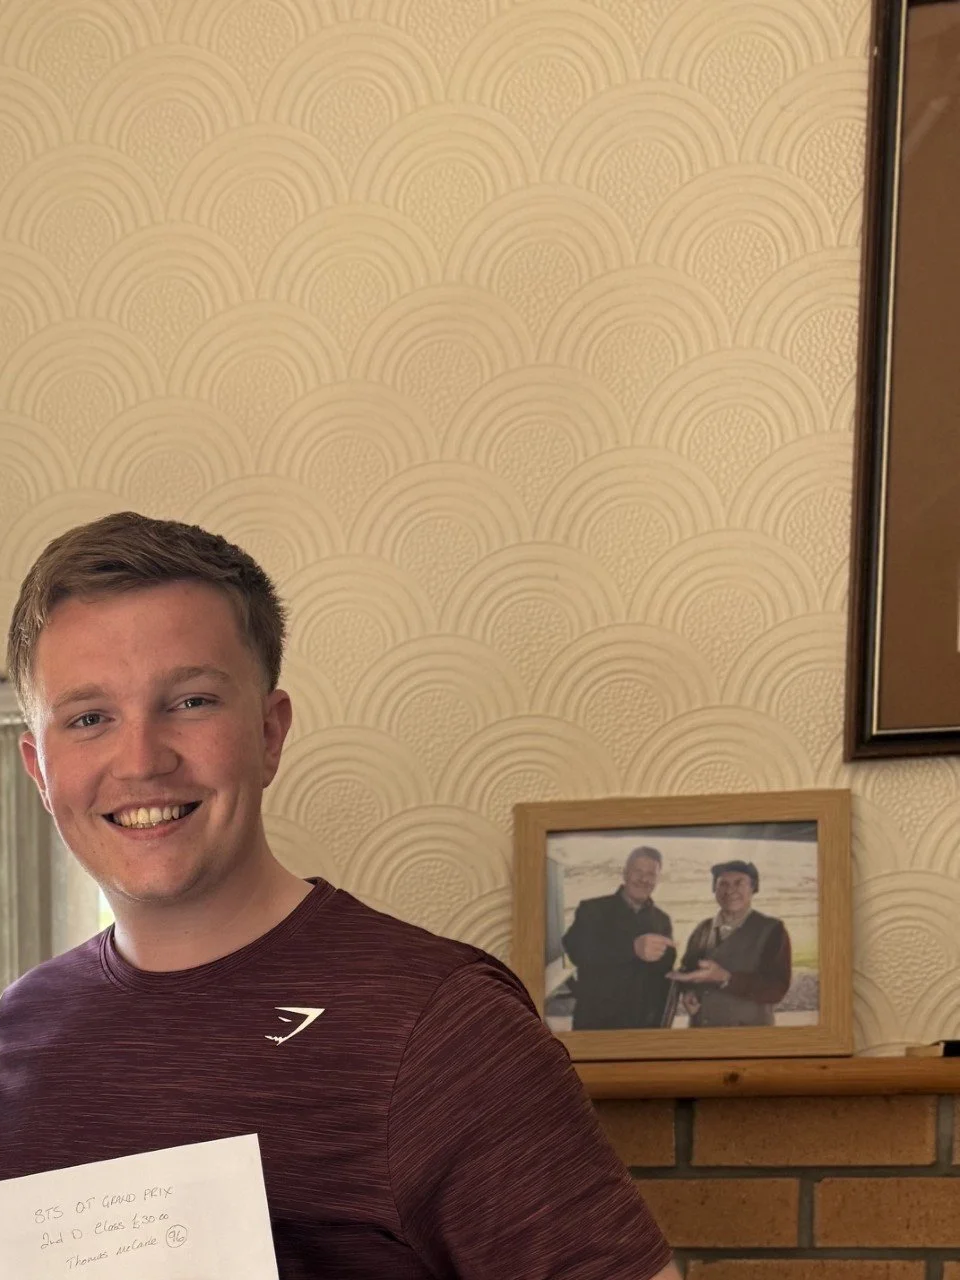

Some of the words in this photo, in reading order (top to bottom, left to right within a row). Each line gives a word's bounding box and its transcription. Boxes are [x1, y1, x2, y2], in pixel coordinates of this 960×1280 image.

[34, 1205, 63, 1224] STS
[102, 1193, 136, 1208] GRAND
[143, 1186, 173, 1201] PRIX
[40, 1232, 63, 1250] 2nd
[71, 1229, 83, 1240] D
[65, 1250, 109, 1270] Thomas
